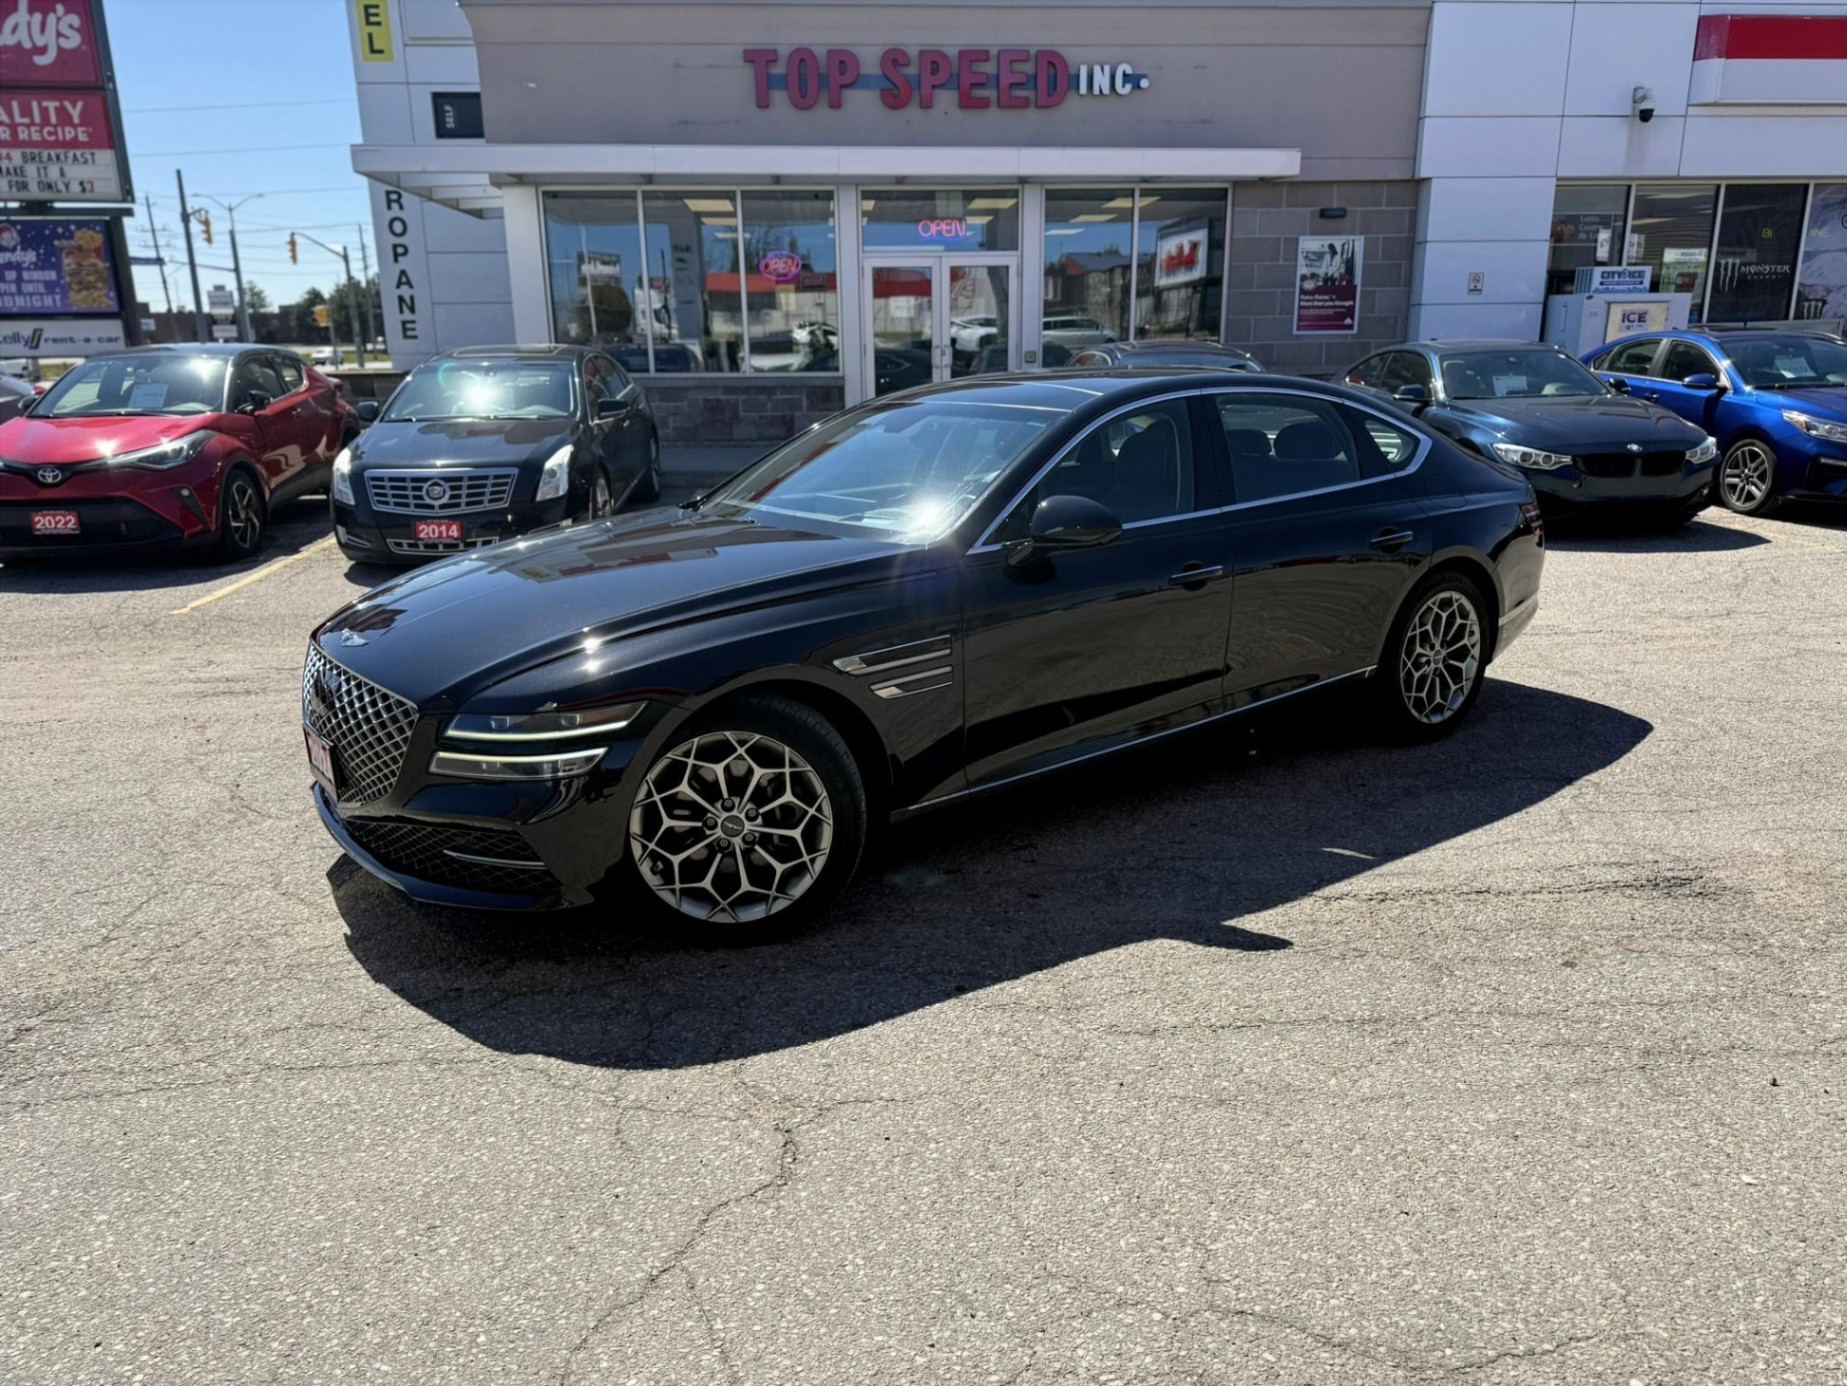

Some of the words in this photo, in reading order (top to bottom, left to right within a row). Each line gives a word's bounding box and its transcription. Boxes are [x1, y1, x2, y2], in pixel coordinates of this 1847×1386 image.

[743, 47, 860, 110] TOP
[879, 47, 1070, 110] SPEED
[1077, 62, 1150, 96] INC.
[444, 104, 455, 129] SELF
[17, 126, 90, 142] RECIPE
[21, 151, 97, 165] BREAKFAST
[36, 165, 49, 178] IT
[59, 165, 67, 178] A
[8, 180, 30, 193] FOR
[37, 180, 71, 194] ONLY
[79, 180, 95, 194] $3
[918, 219, 966, 237] OPEN
[763, 257, 797, 274] OPEN
[1739, 263, 1791, 275] MONSTER
[1600, 270, 1622, 280] CITY
[1628, 270, 1646, 280] ICE
[1621, 311, 1648, 324] ICE
[34, 515, 77, 529] 2022
[418, 524, 459, 538] 2014
